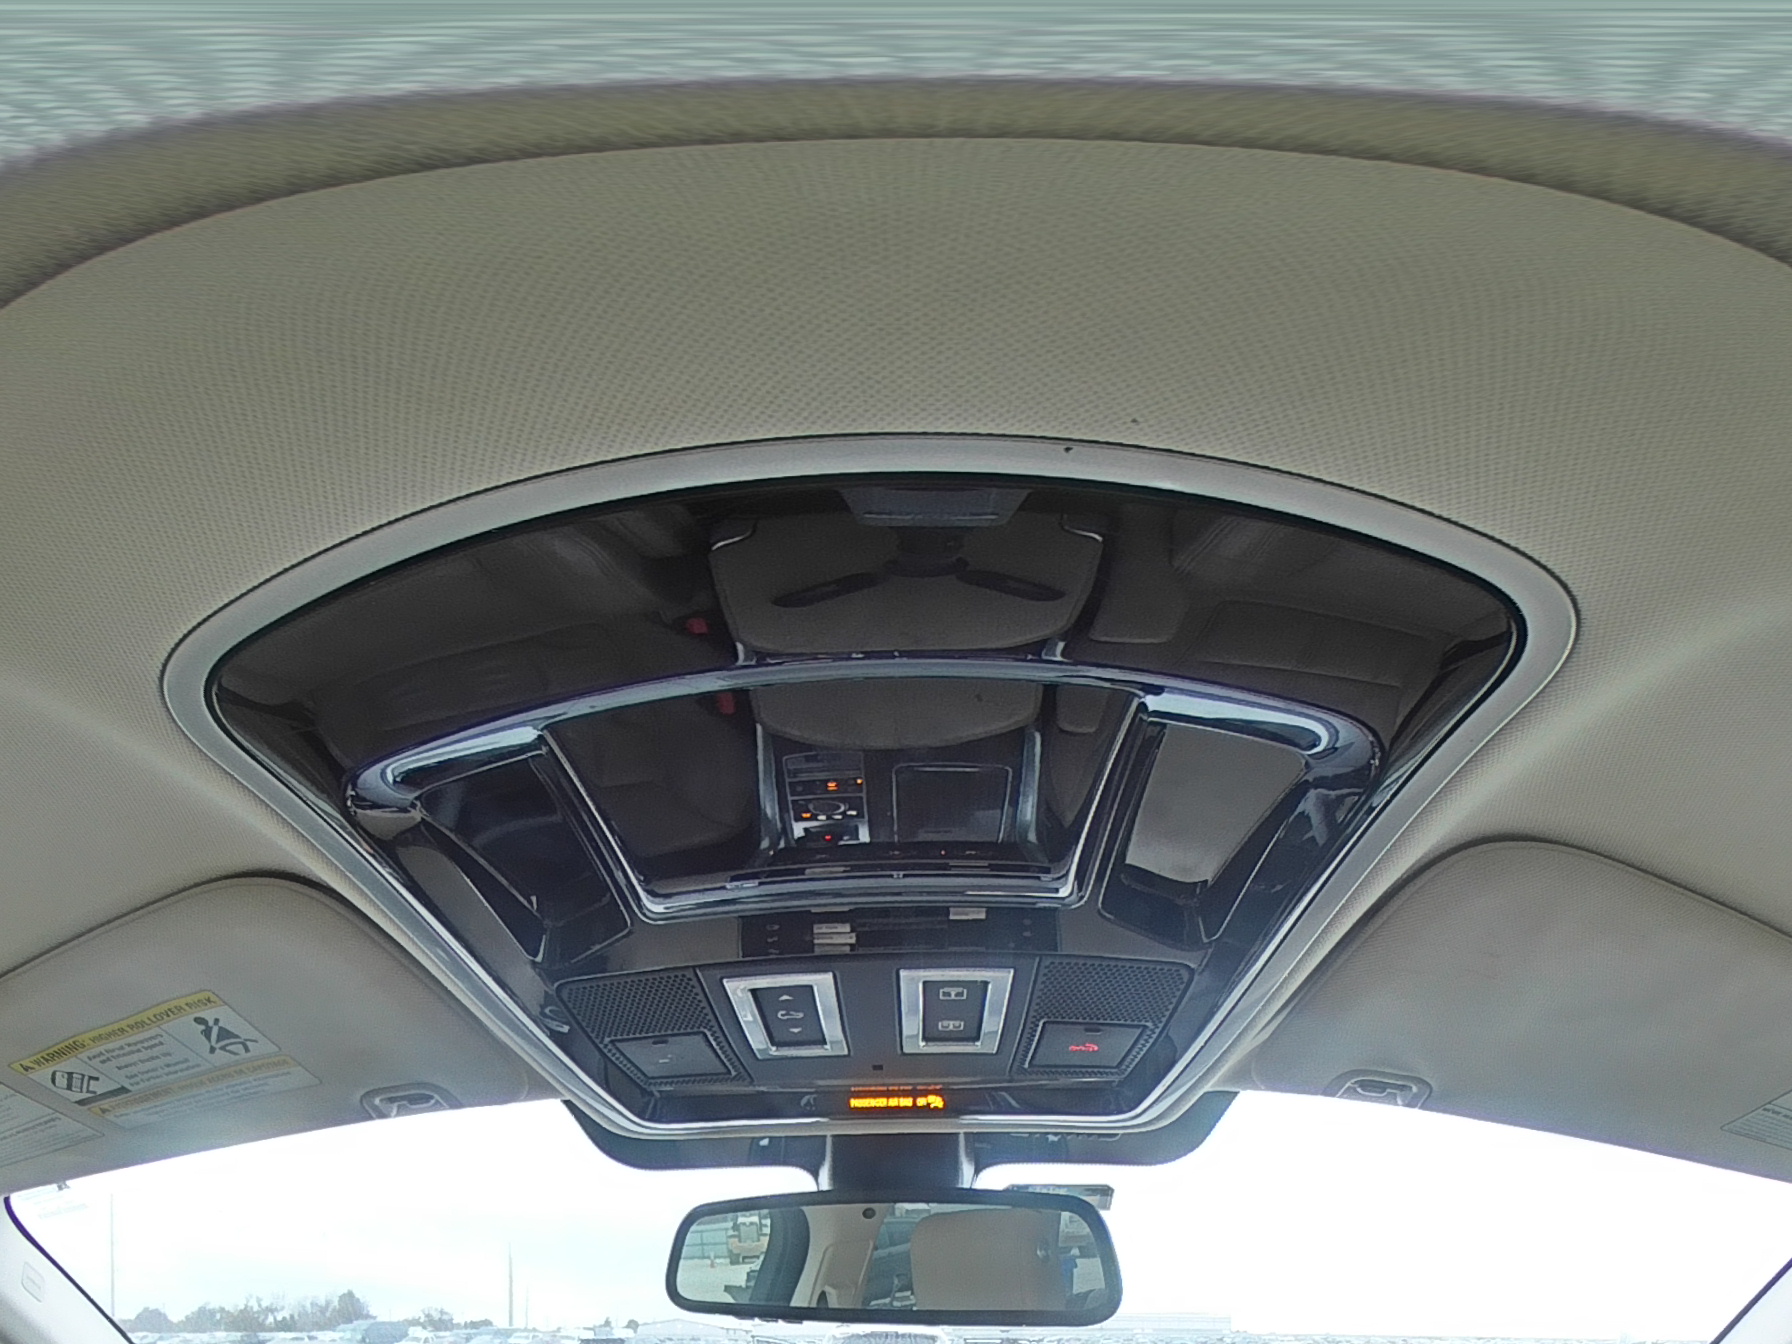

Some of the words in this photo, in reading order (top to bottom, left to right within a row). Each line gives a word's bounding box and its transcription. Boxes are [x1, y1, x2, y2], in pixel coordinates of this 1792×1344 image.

[33, 1040, 88, 1068] WARNING:
[90, 1027, 127, 1046] HIGHER
[128, 1004, 184, 1035] ROLLOVER
[185, 996, 216, 1014] RISK
